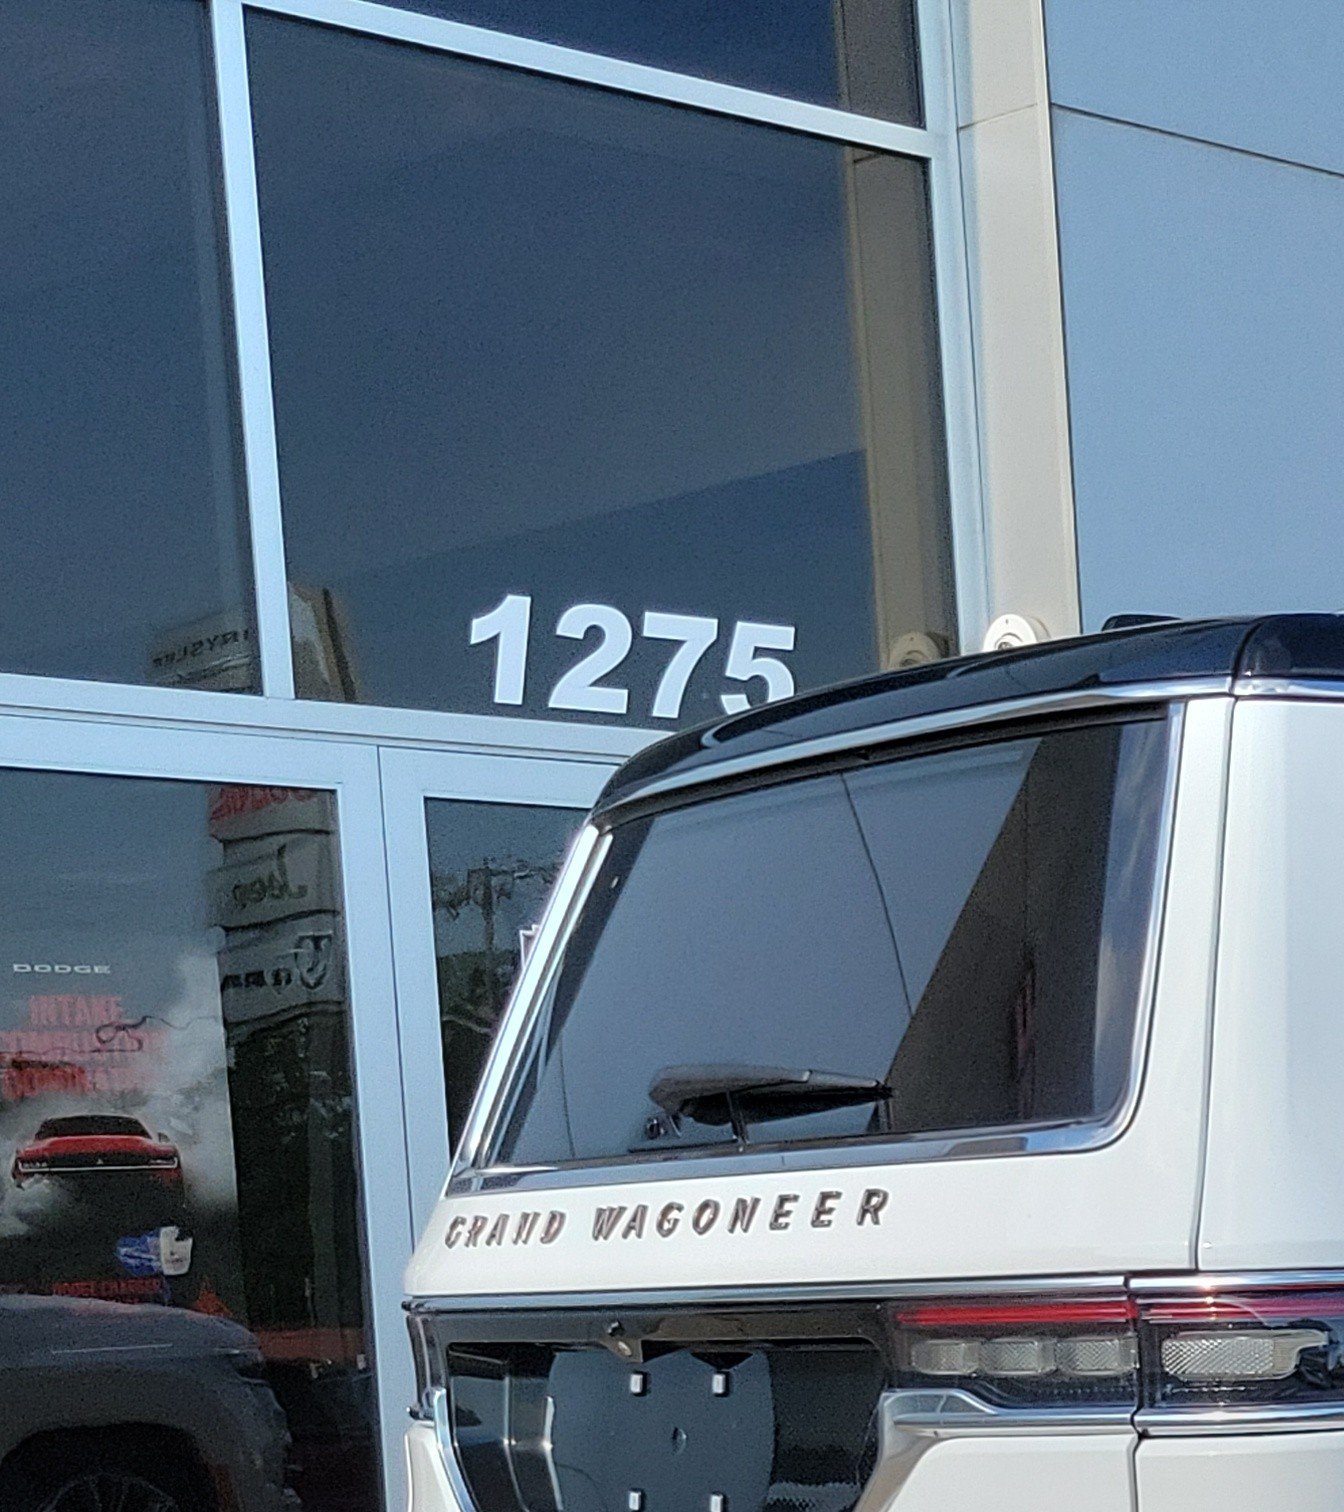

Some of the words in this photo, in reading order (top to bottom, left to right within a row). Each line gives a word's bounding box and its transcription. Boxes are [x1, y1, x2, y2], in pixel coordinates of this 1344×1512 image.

[470, 594, 795, 718] 1275
[12, 963, 111, 975] DODGE
[445, 1210, 566, 1249] GRAND
[591, 1188, 890, 1242] WAGONEER
